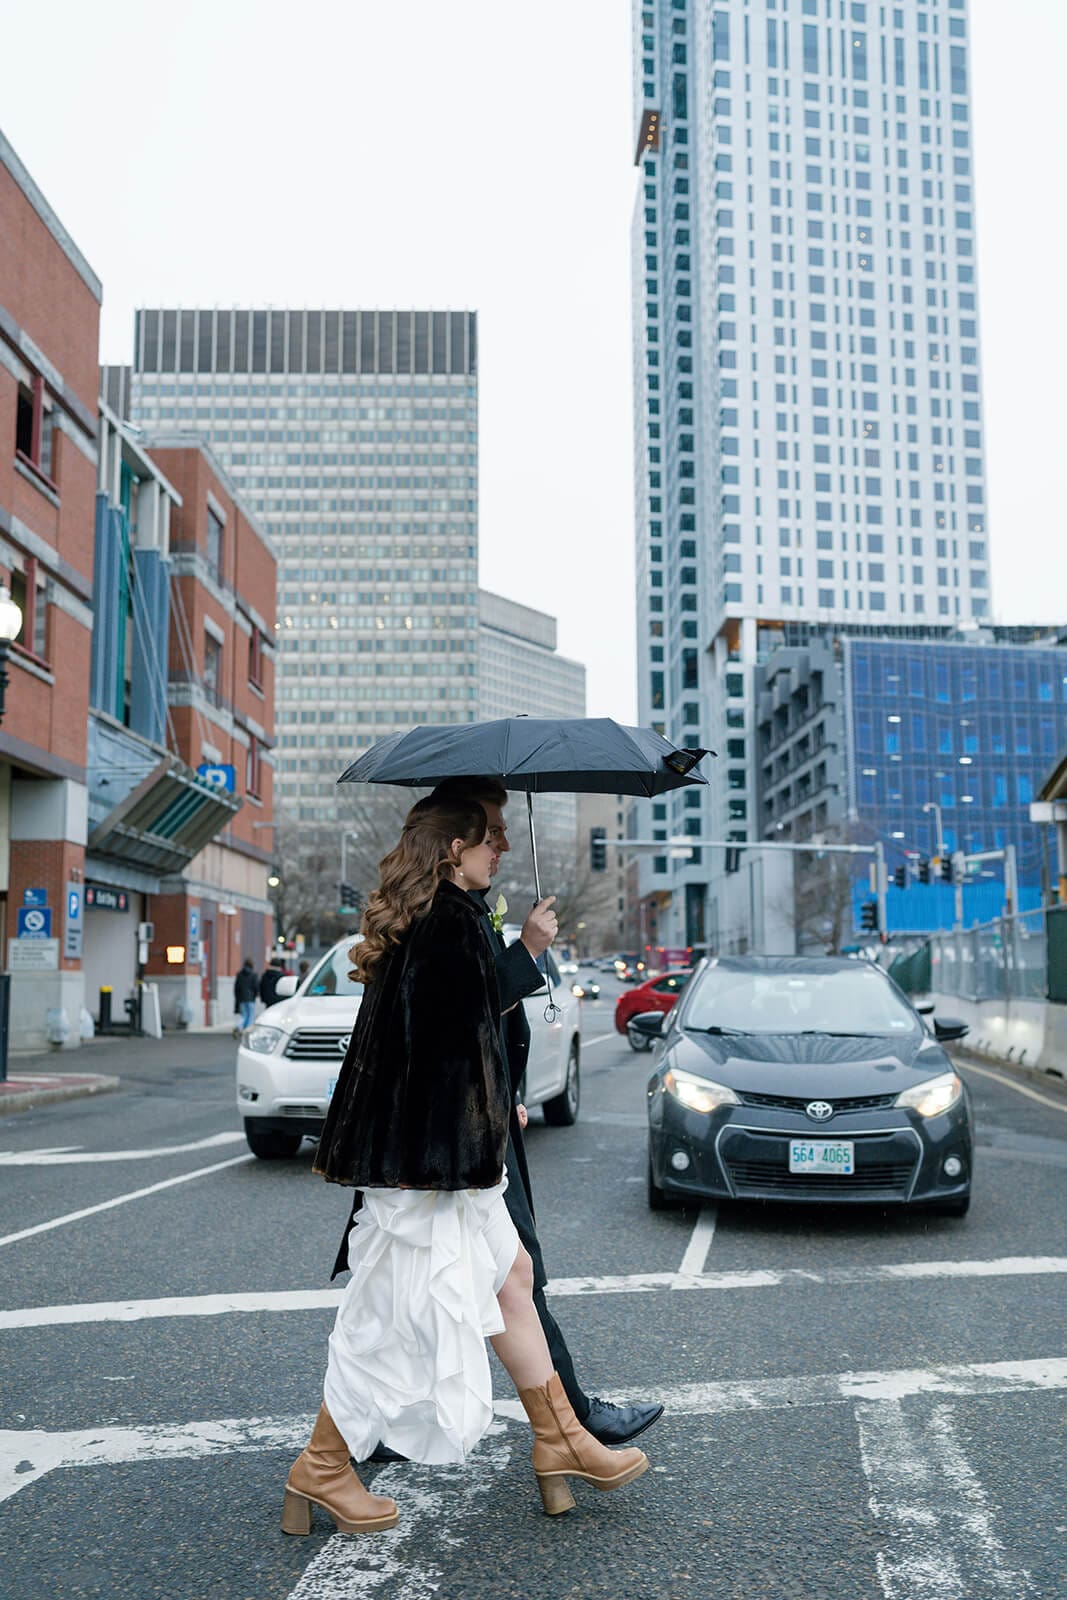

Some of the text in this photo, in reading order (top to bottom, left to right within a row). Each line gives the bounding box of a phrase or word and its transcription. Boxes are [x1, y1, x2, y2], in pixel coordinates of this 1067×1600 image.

[71, 895, 79, 915] P
[793, 1147, 850, 1163] 564 4065
